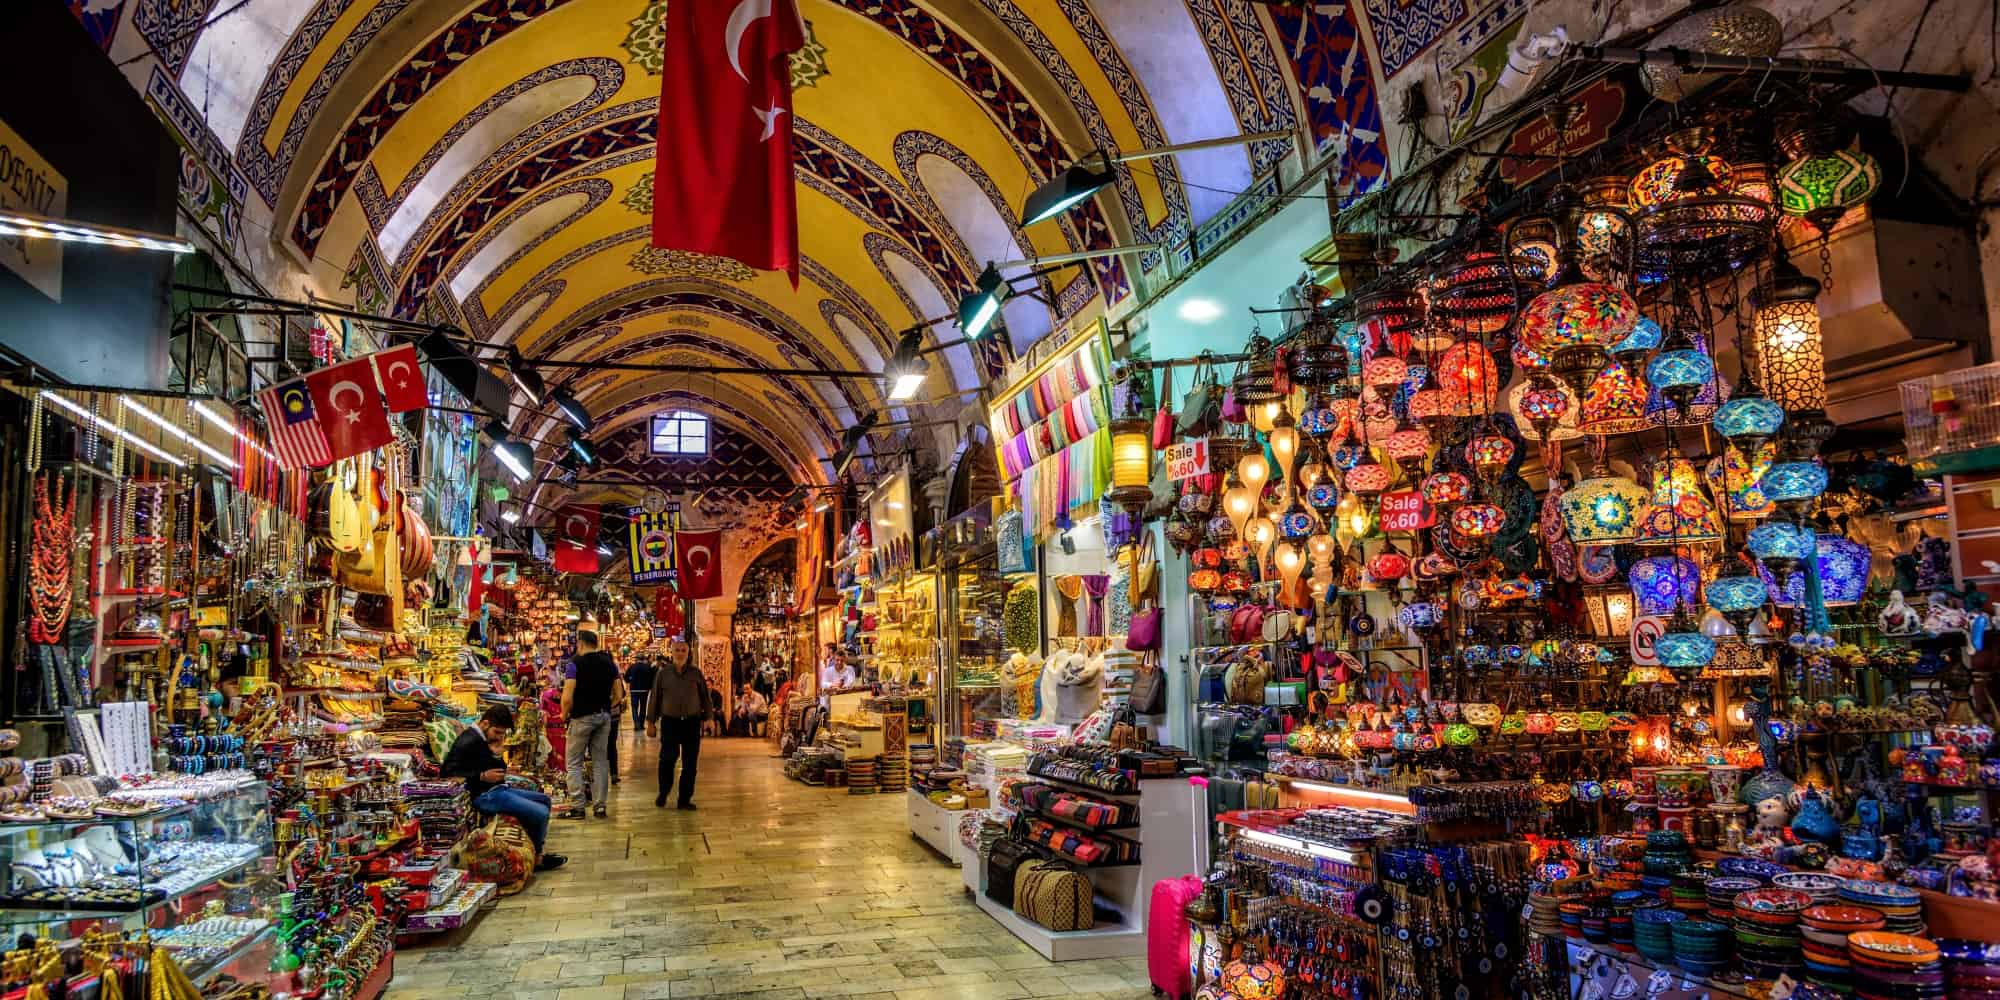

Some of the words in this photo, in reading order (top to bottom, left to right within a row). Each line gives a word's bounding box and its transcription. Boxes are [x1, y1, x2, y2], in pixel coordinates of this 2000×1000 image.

[1167, 445, 1193, 462] Sale
[1168, 460, 1194, 480] %60
[1383, 495, 1419, 511] Sale
[1382, 512, 1419, 531] %60
